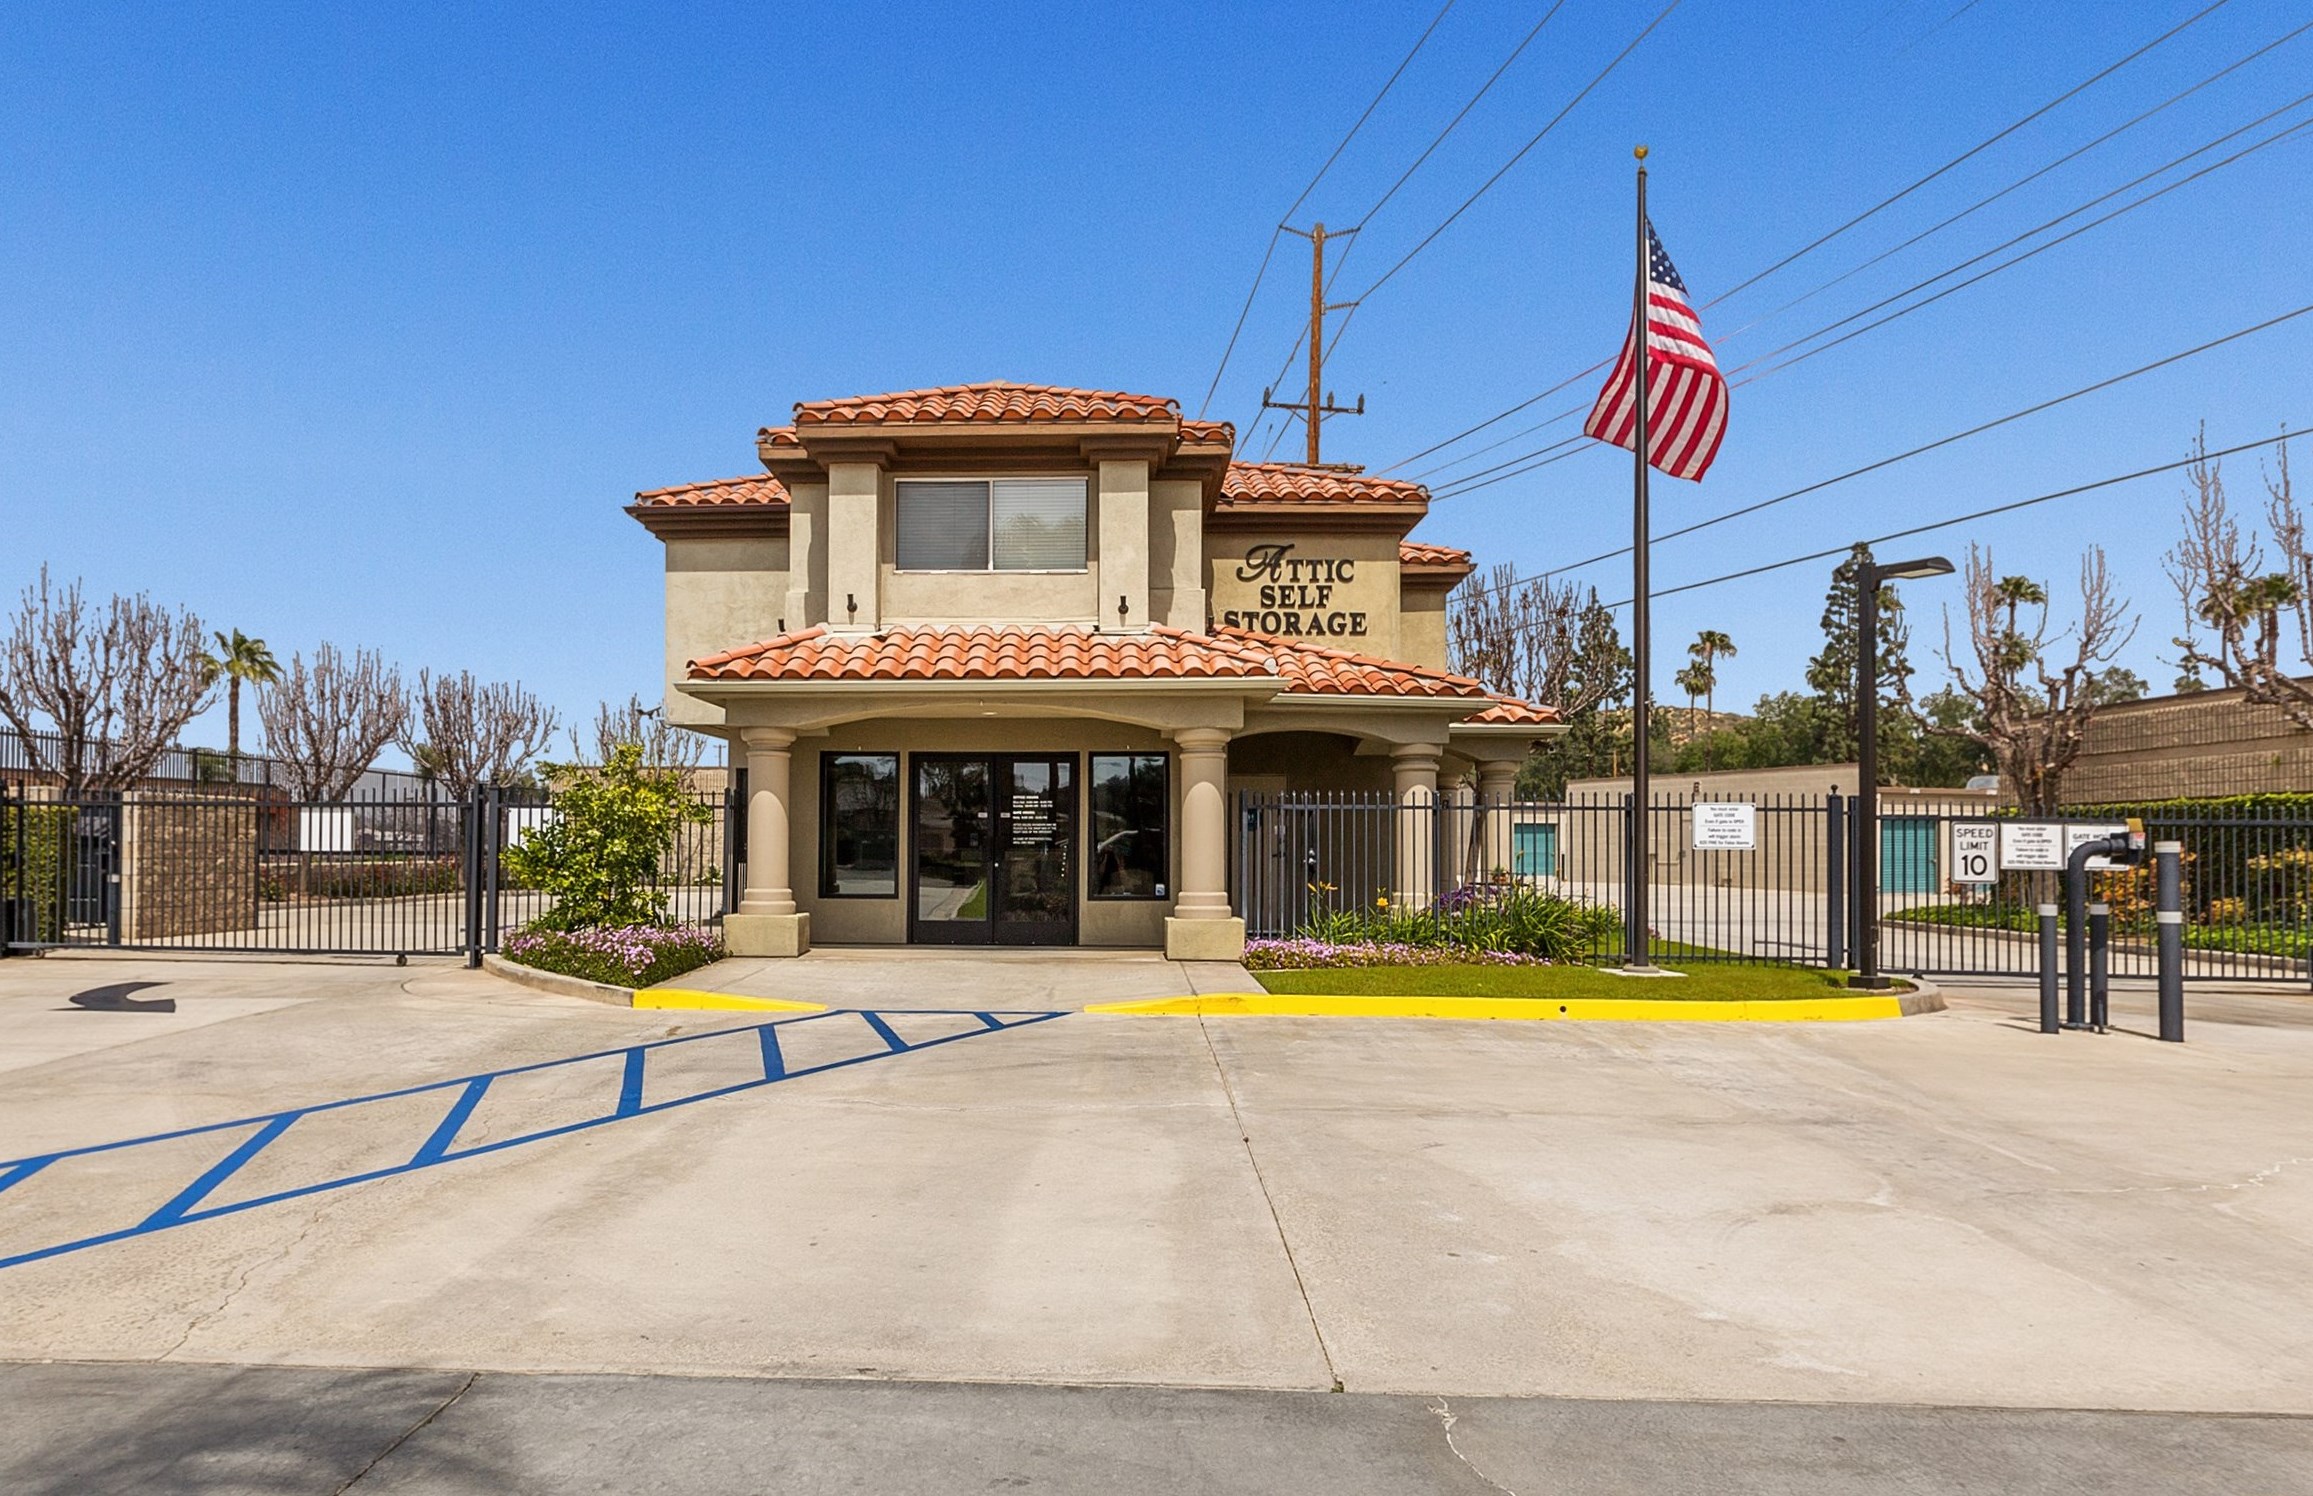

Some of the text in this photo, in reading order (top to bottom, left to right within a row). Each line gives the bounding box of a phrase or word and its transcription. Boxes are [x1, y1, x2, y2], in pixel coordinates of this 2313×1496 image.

[1236, 543, 1355, 583] ATTIC
[1260, 585, 1333, 609] SELF
[1224, 610, 1368, 636] STORAGE
[1956, 828, 1994, 838] SPEED
[1960, 841, 1988, 850] LIMIT
[1961, 854, 1988, 876] 10
